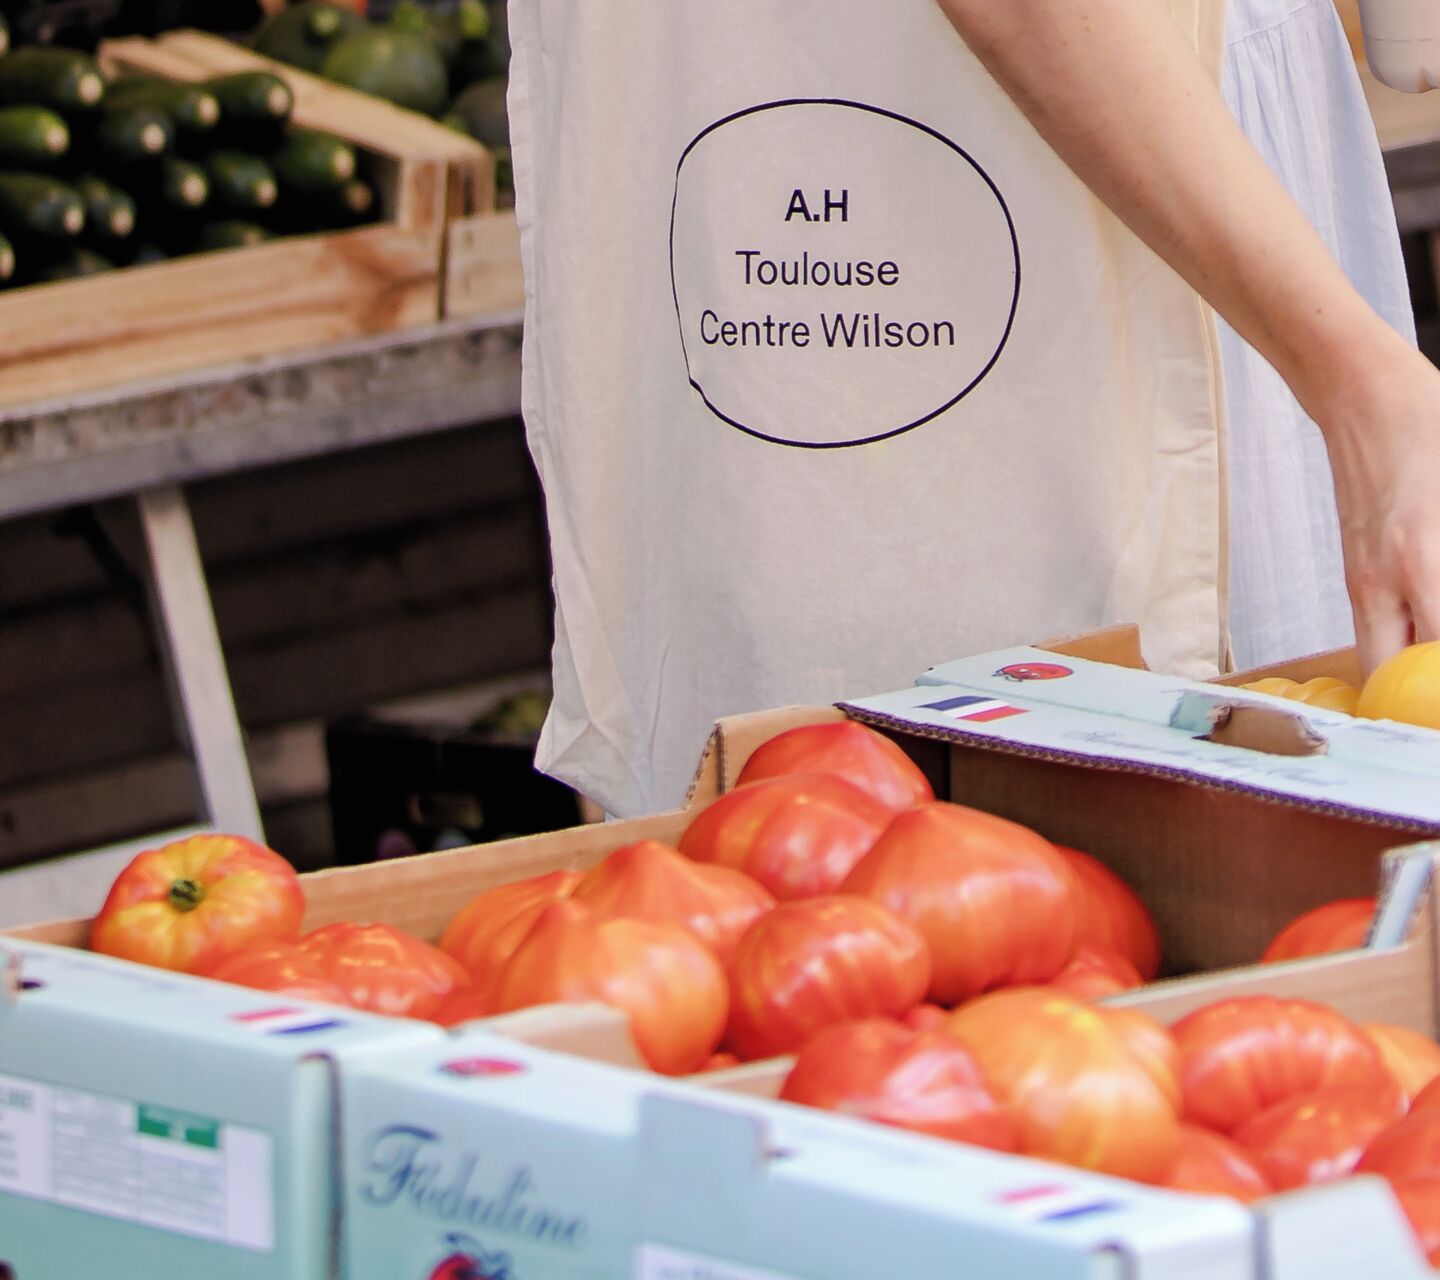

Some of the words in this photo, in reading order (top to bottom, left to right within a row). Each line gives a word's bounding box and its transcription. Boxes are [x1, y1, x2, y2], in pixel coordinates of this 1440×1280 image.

[785, 189, 848, 222] A.H
[735, 251, 900, 286] Toulouse
[700, 310, 811, 347] Centre
[820, 313, 956, 347] Wilson
